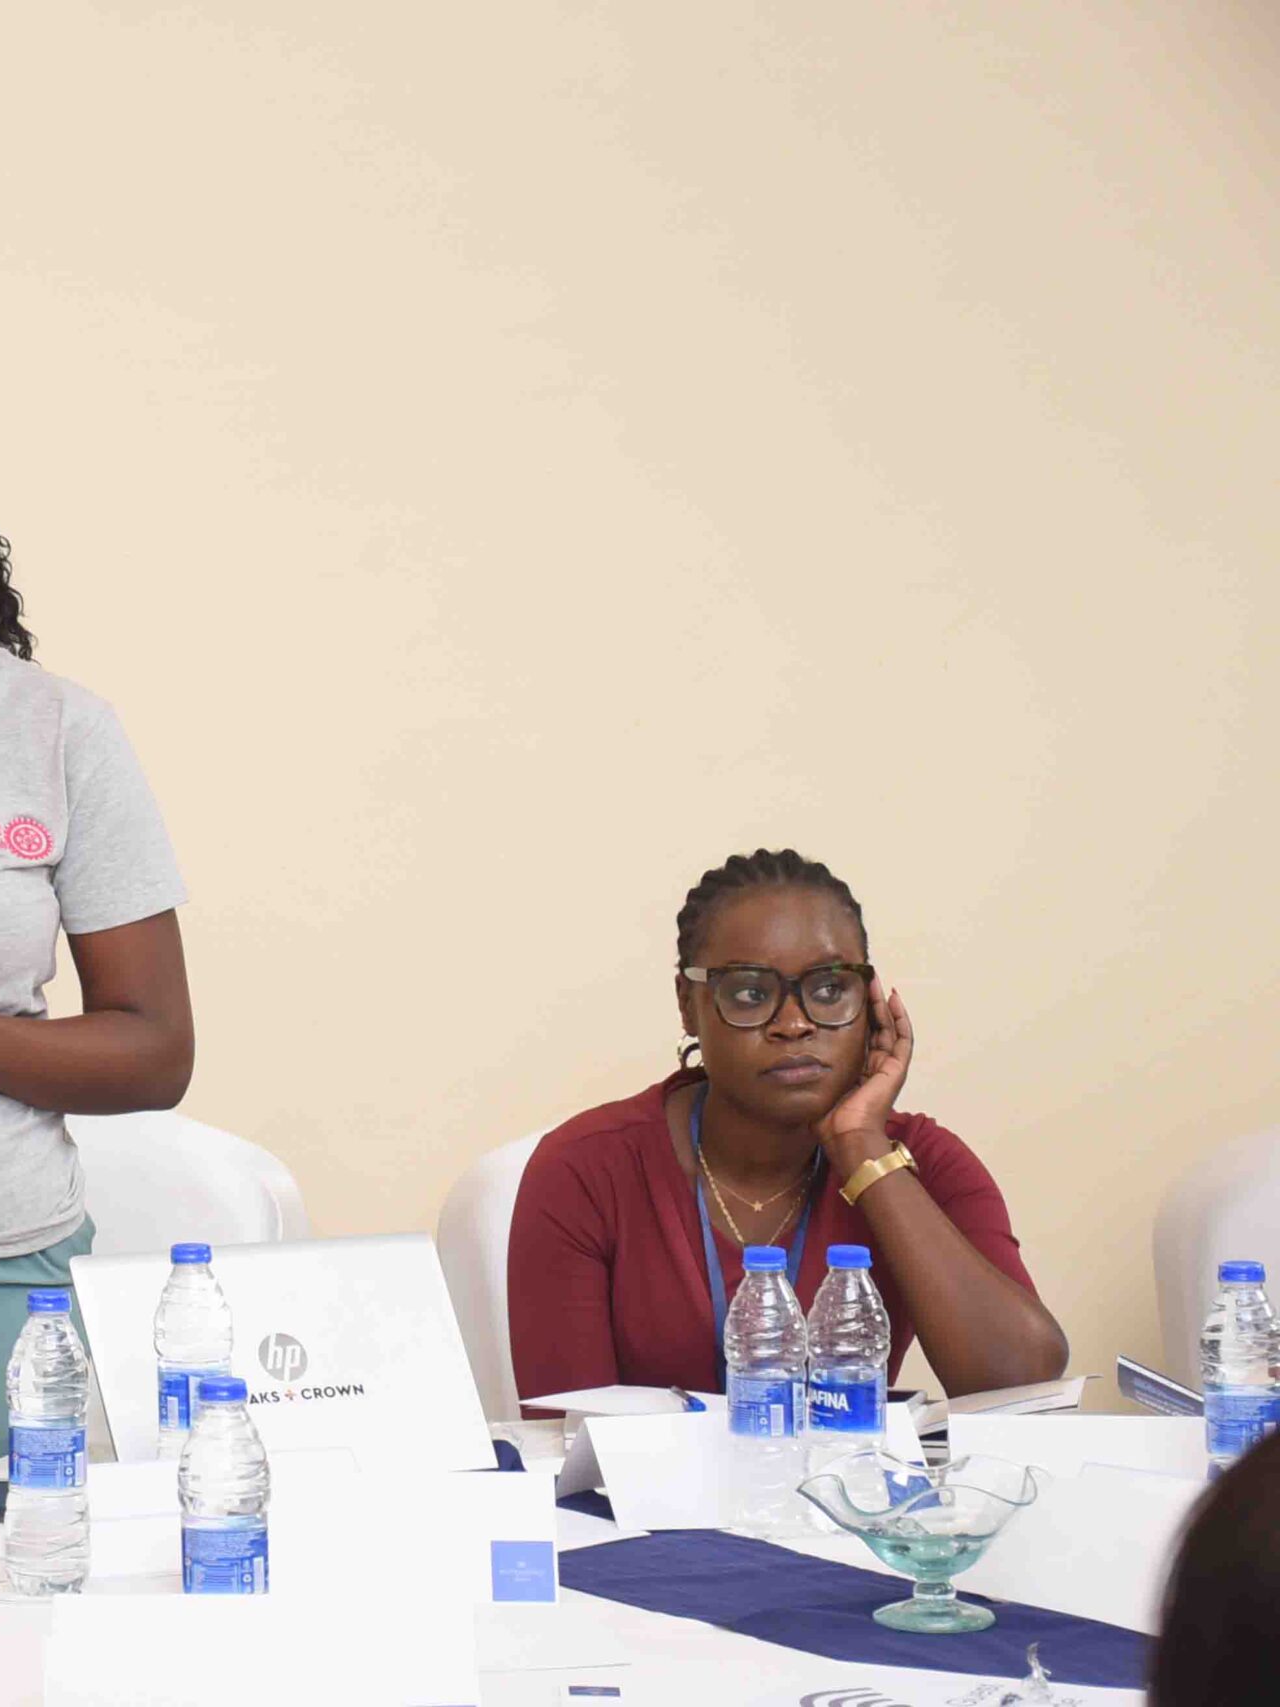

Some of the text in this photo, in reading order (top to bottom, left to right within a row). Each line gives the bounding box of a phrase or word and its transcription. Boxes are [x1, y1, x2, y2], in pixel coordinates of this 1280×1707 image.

[249, 1391, 280, 1405] AKS
[301, 1384, 365, 1400] CROWN
[808, 1389, 850, 1411] AFINA
